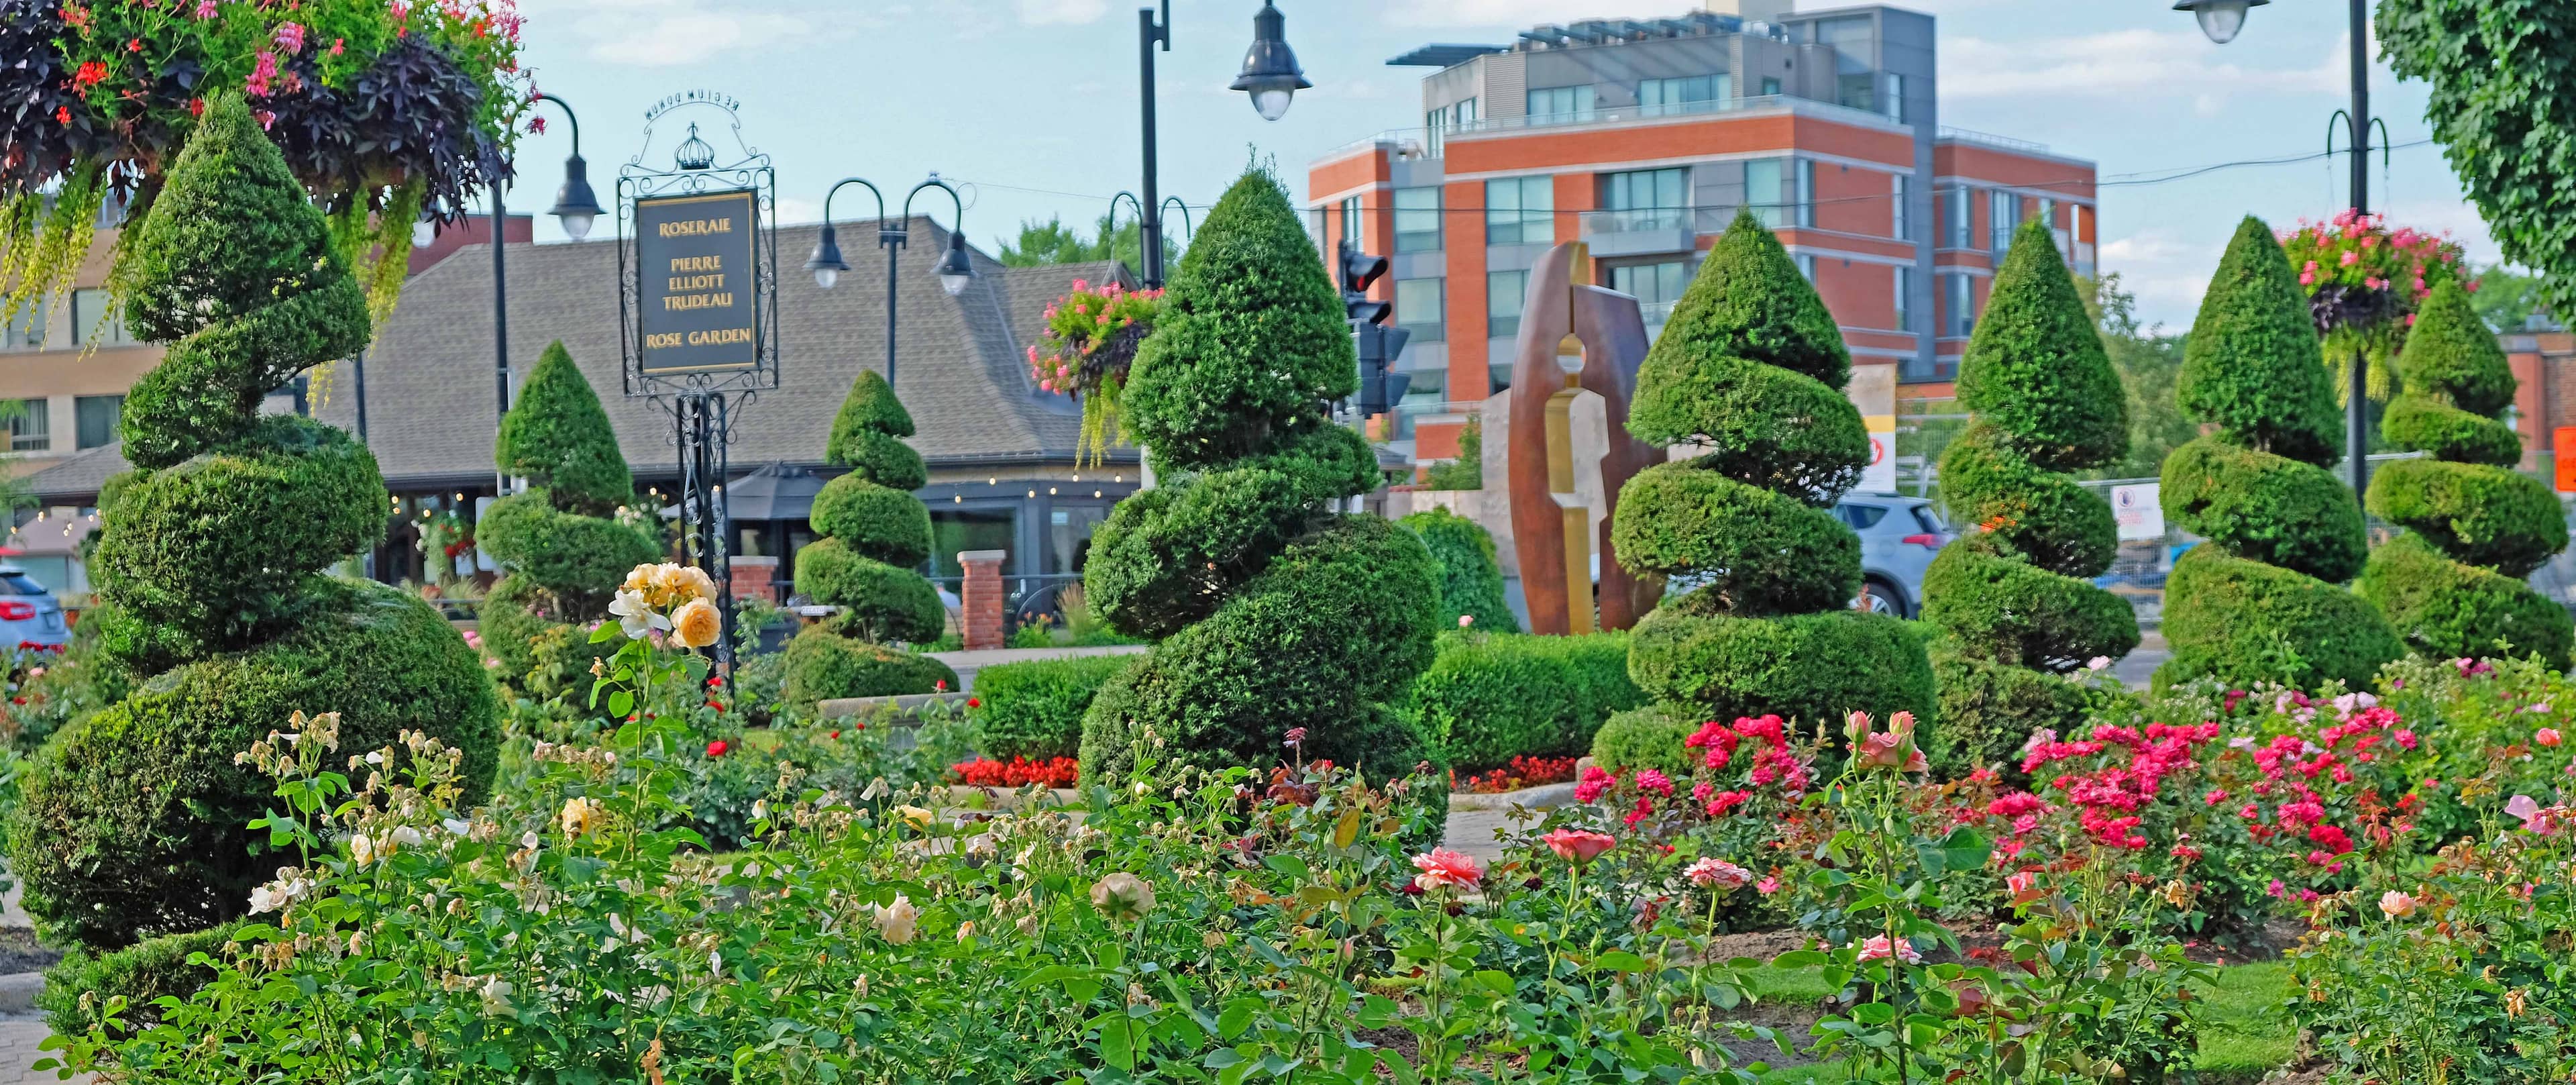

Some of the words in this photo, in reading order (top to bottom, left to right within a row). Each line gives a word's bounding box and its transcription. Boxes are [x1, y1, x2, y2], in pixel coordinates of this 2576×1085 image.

[659, 217, 731, 237] ROSERAIE
[671, 255, 722, 272] PIERRE
[669, 274, 724, 291] ELLIOTT
[662, 292, 733, 311] TRUDEAU
[646, 332, 683, 349] ROSE
[688, 327, 751, 346] GARDEN
